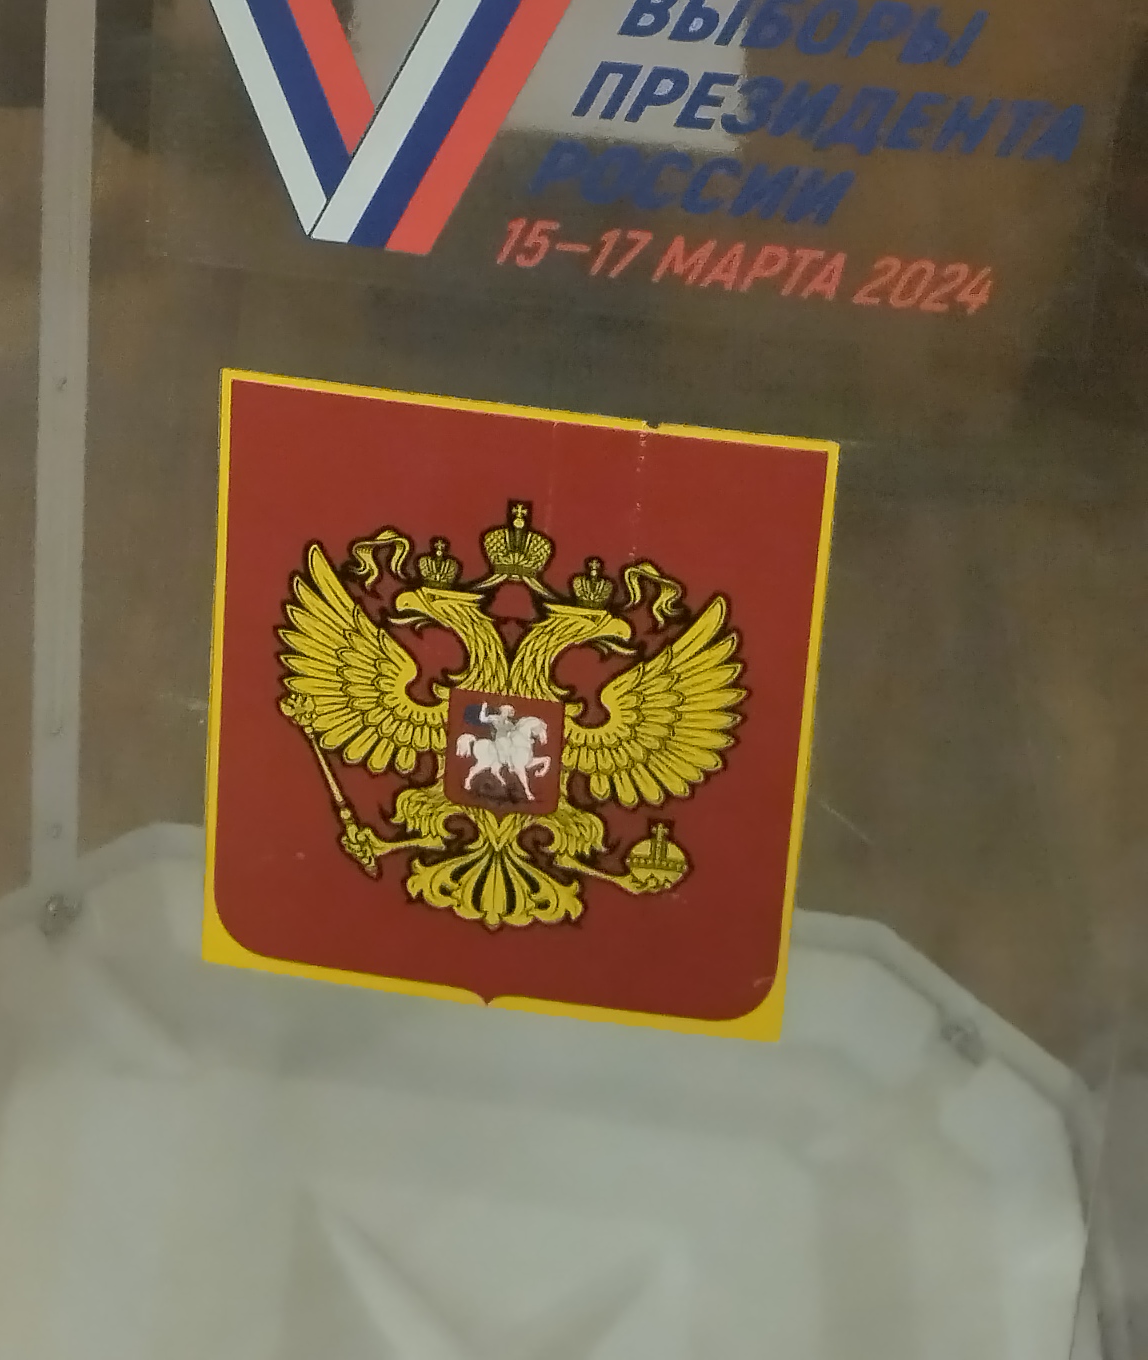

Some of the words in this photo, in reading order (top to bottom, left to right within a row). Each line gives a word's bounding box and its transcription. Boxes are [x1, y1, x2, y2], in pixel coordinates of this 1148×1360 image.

[570, 60, 1086, 164] ПРЕЗИДЕНТА
[528, 138, 856, 226] РОССИИ
[651, 234, 848, 303] МАРТА
[852, 254, 993, 316] 2024
